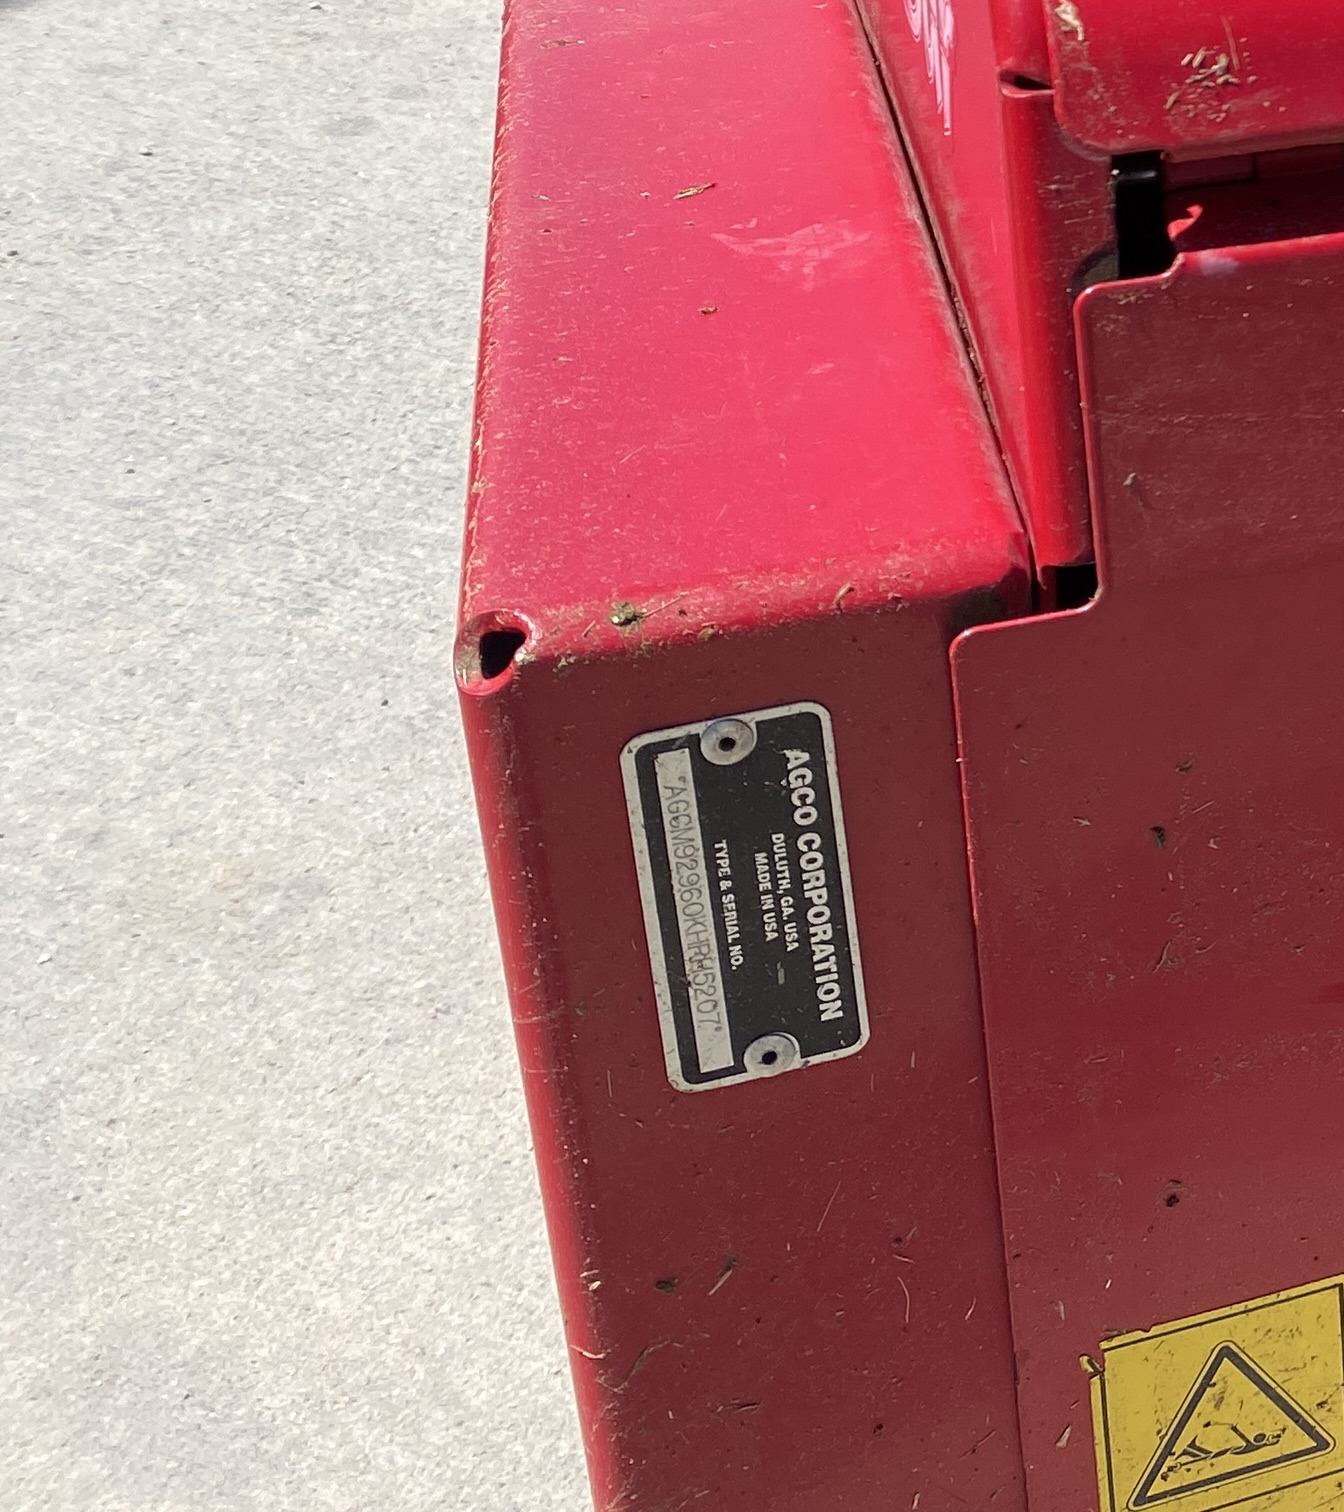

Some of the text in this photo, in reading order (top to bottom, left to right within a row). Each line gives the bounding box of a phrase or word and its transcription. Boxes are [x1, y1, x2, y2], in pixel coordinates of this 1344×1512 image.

[714, 839, 744, 971] TYPE & SERIAL NO.
[754, 852, 779, 942] MADE IN USA
[771, 832, 800, 952] DULUTH, GA. USA
[784, 748, 844, 1022] AGCO CORPORATION
